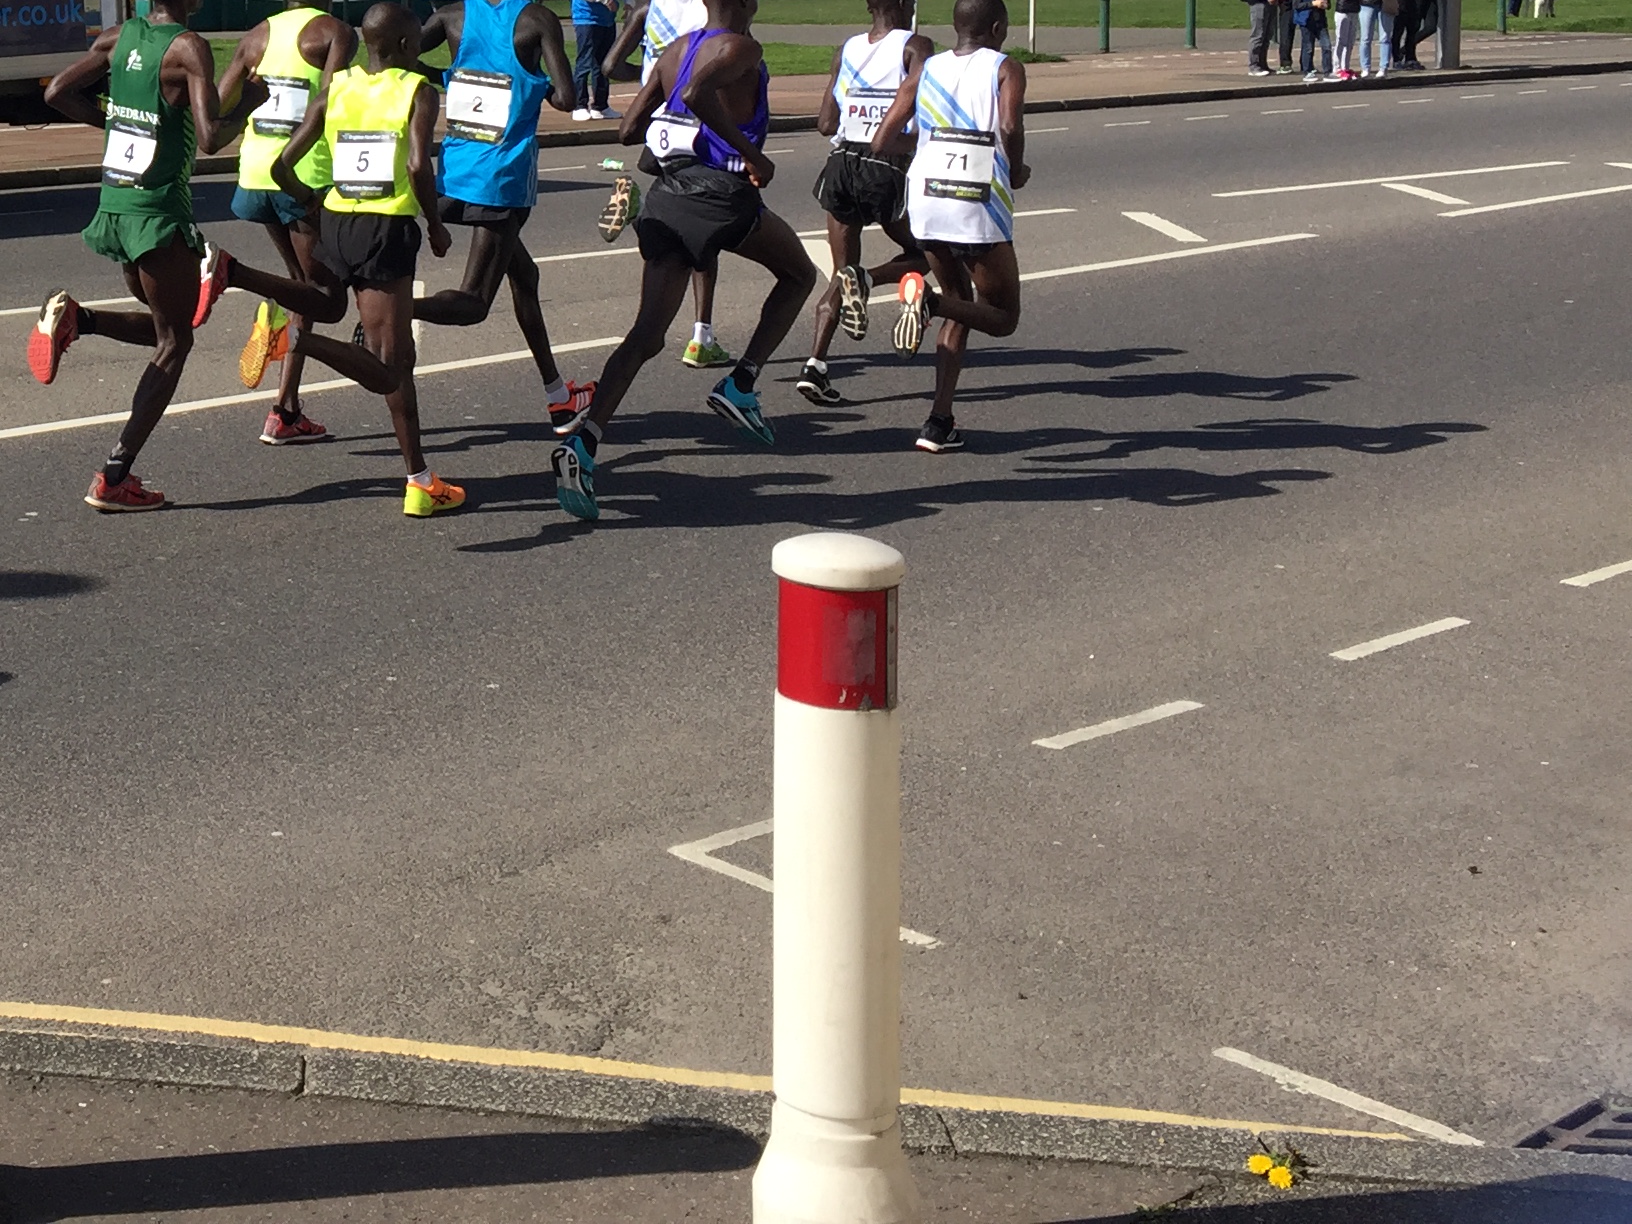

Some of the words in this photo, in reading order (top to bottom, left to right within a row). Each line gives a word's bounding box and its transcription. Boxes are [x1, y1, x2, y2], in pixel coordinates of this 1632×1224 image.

[272, 92, 280, 112] 1
[472, 95, 484, 113] 2
[848, 104, 889, 118] PACE
[113, 104, 162, 126] NEDBANK
[659, 129, 670, 151] 8
[124, 143, 135, 163] 4
[356, 150, 370, 172] 5
[945, 152, 968, 171] 71
